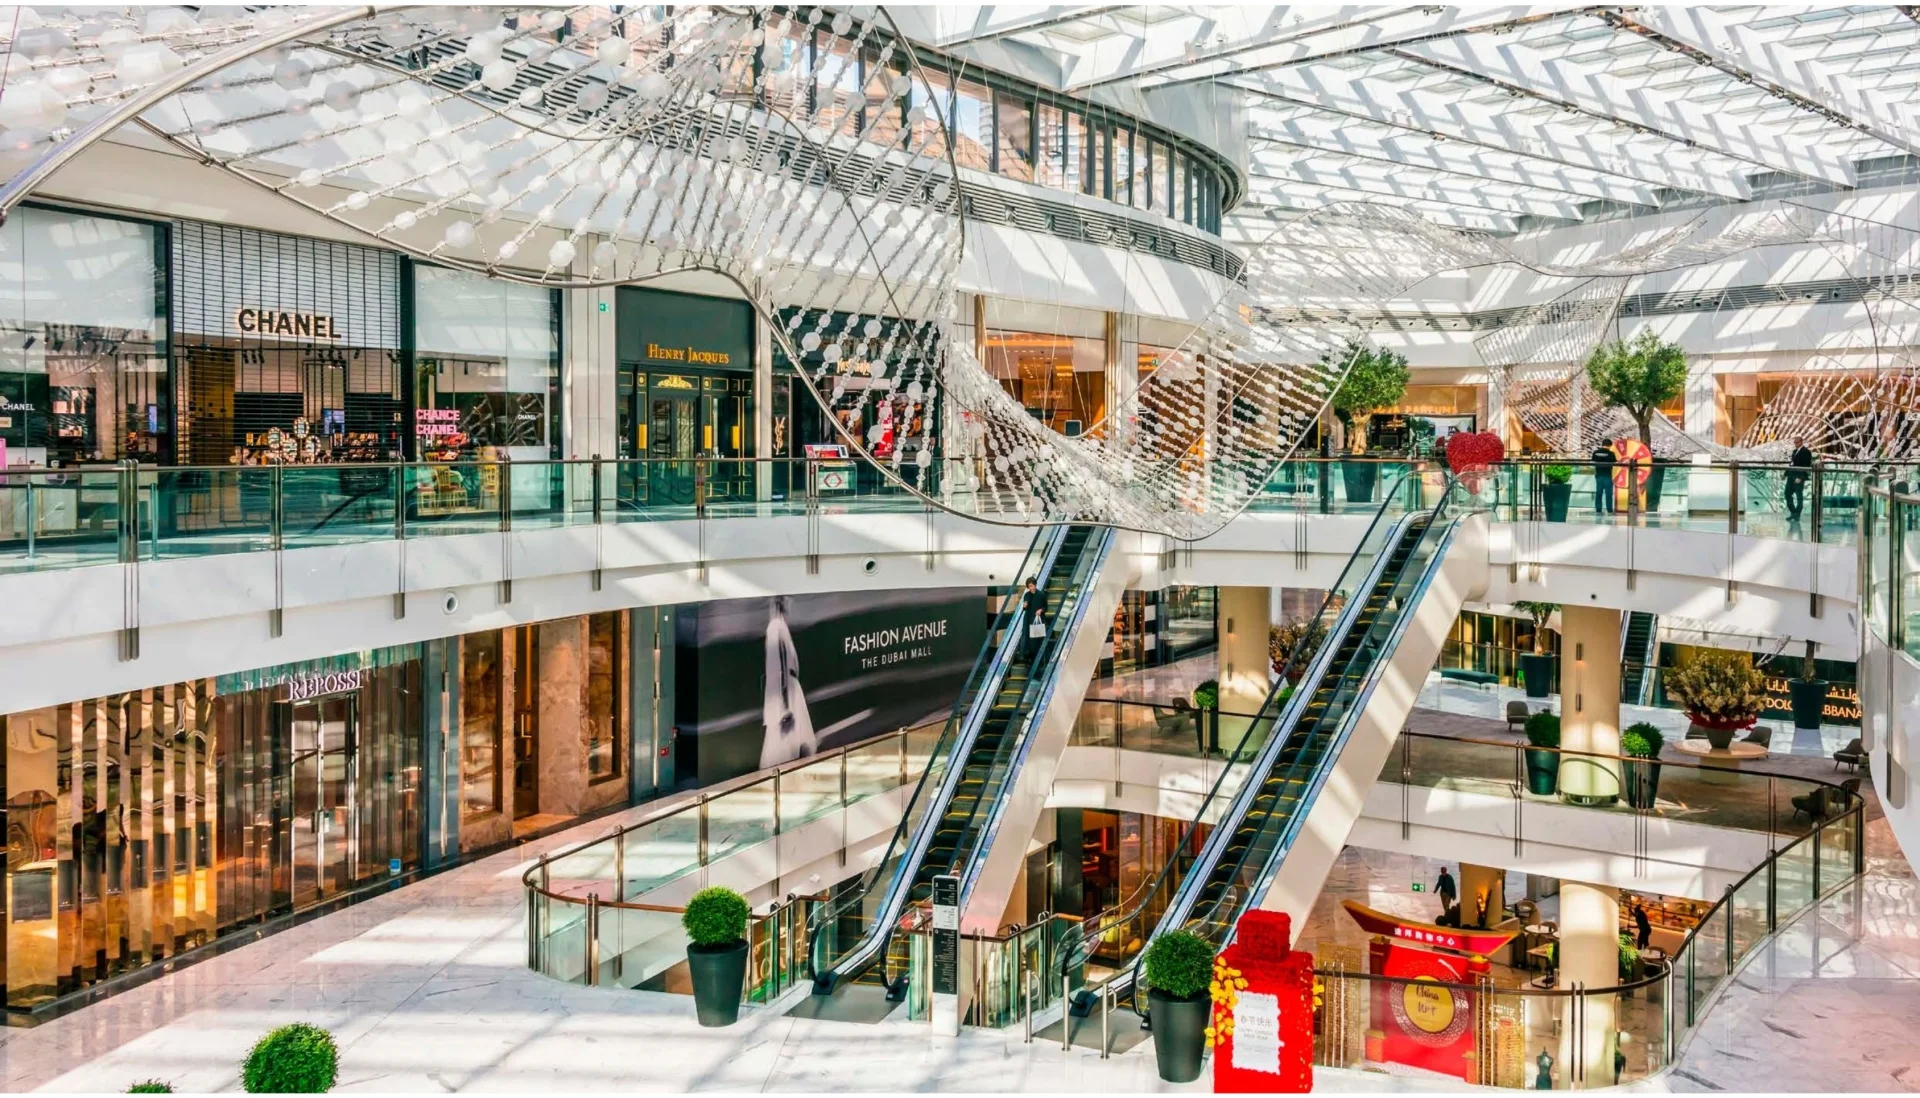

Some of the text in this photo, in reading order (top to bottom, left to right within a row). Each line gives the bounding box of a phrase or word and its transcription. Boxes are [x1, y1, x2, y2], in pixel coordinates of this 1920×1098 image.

[238, 308, 342, 339] CHANEL
[1, 403, 36, 411] CHANEL
[415, 409, 460, 420] CHANCE
[415, 424, 459, 435] CHANEL
[844, 619, 948, 654] FASHION AVENUE
[861, 645, 932, 669] THE DUBAI MALL
[287, 669, 362, 701] REPOSSI
